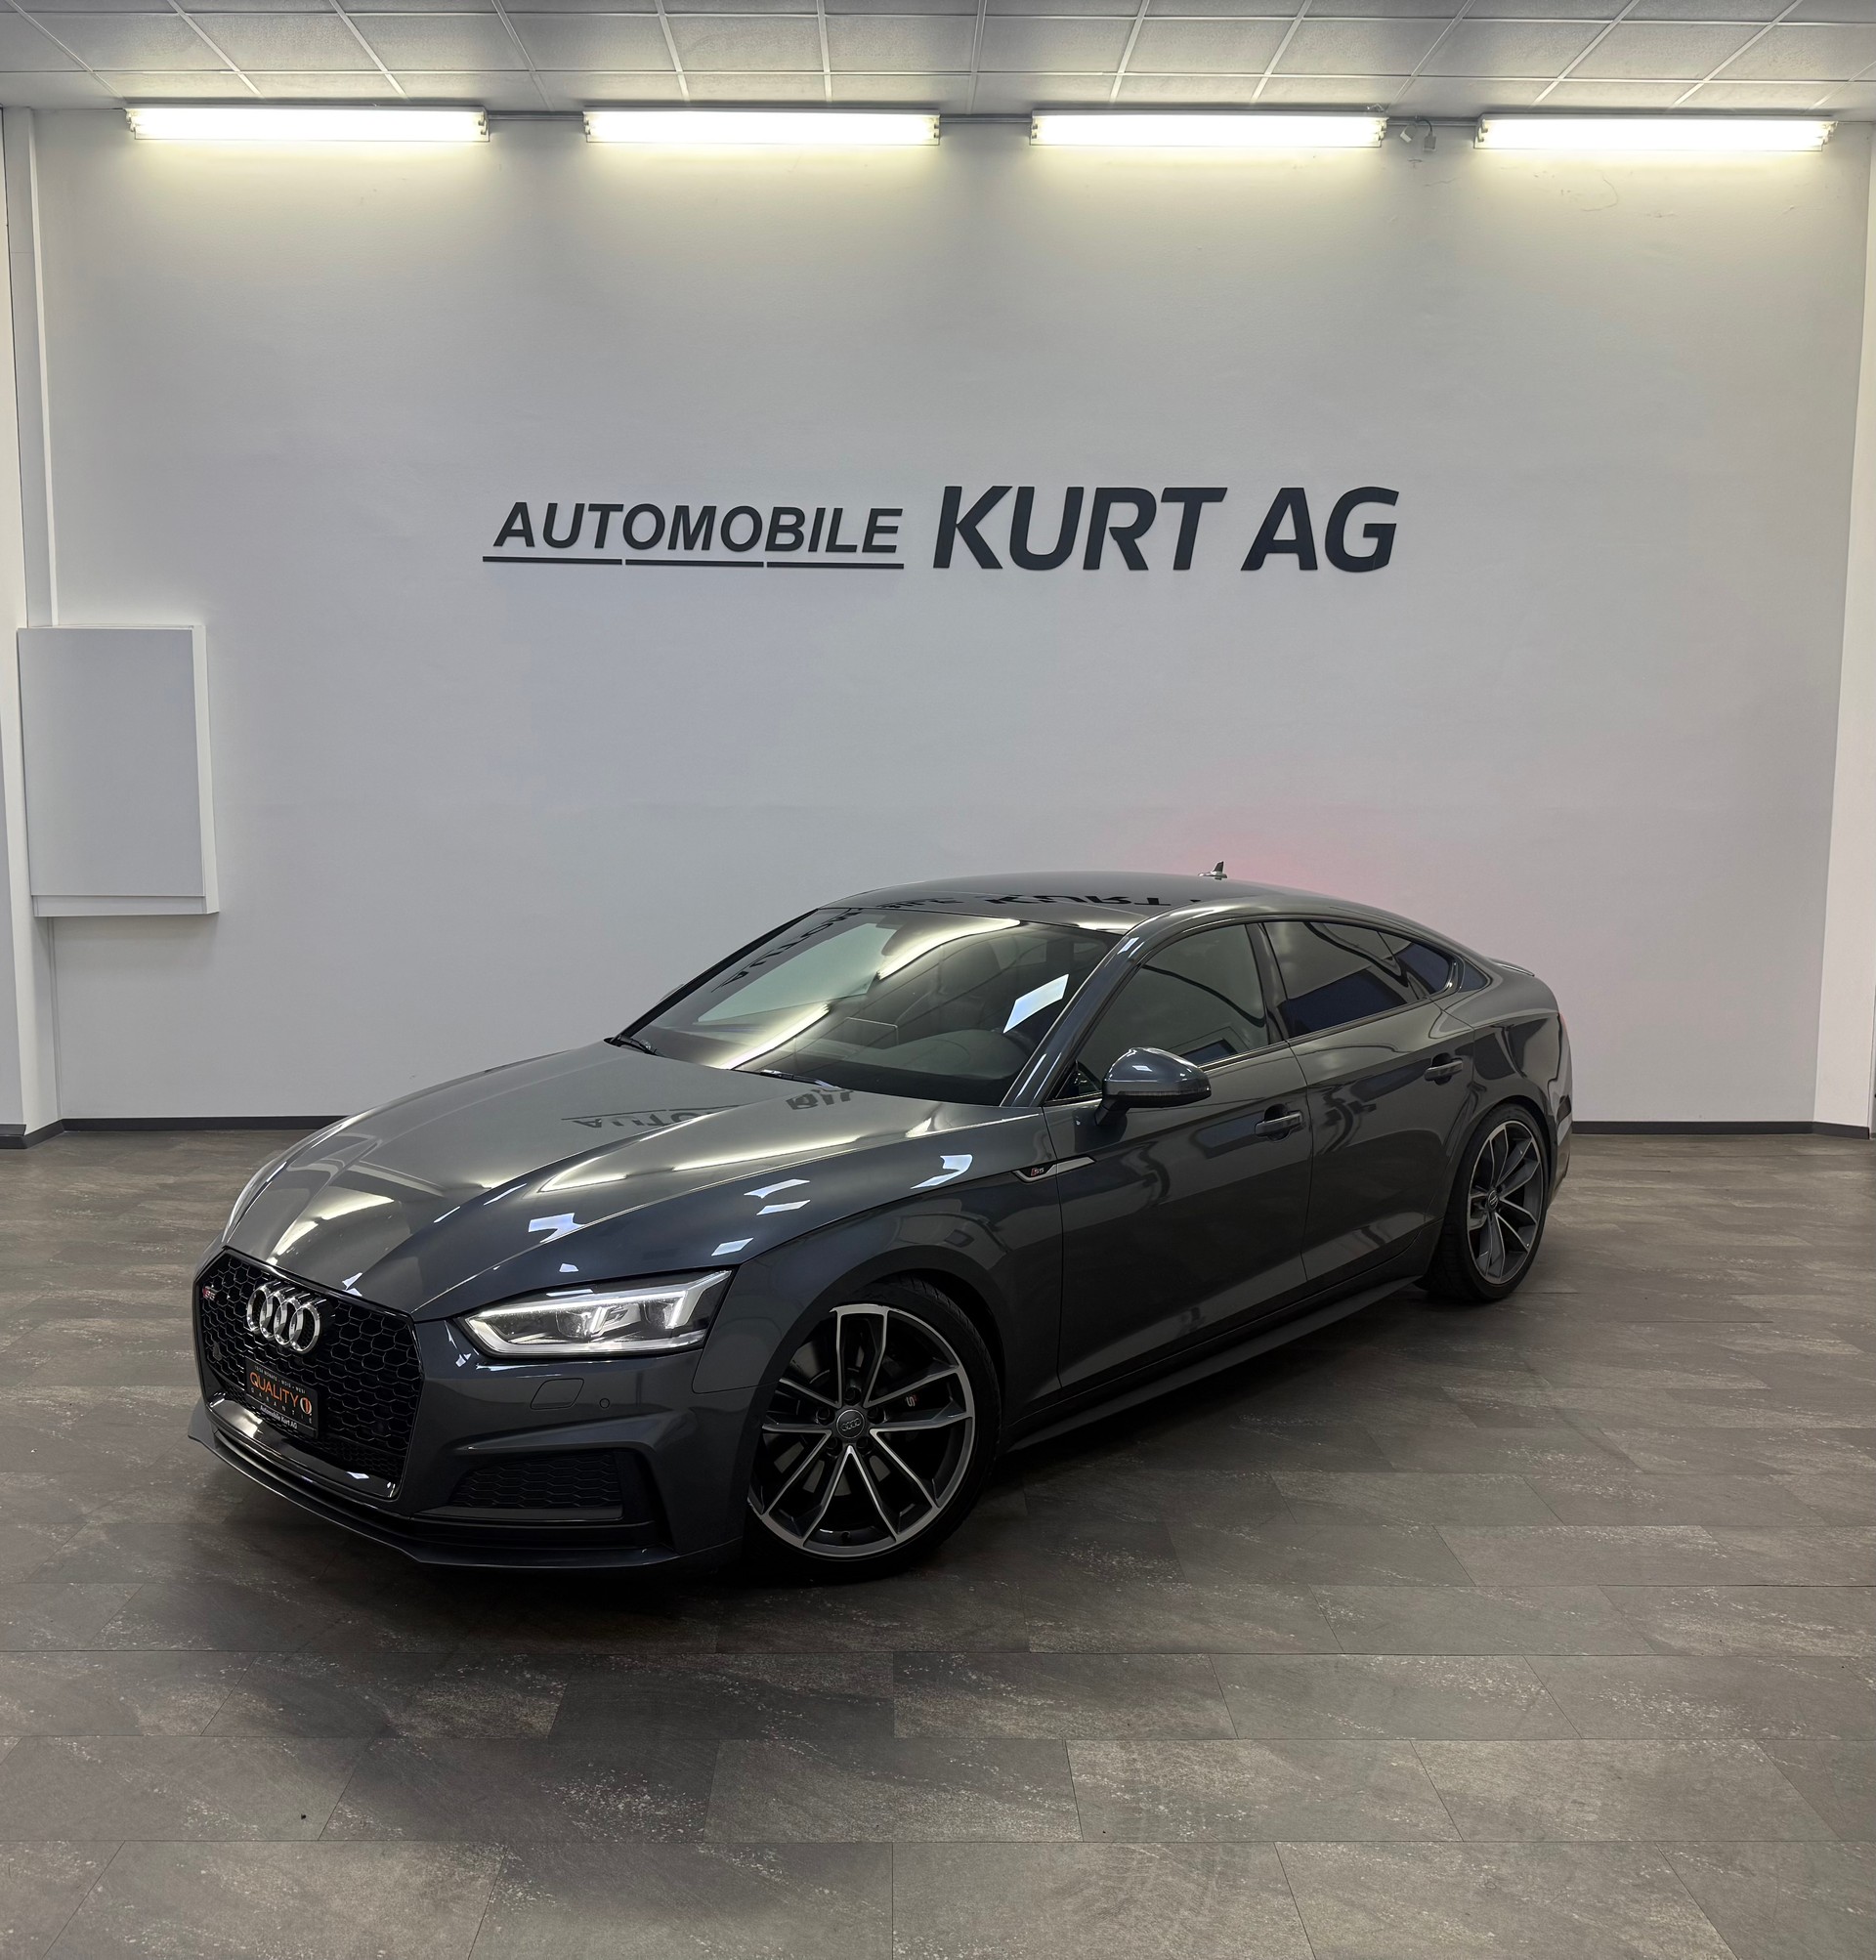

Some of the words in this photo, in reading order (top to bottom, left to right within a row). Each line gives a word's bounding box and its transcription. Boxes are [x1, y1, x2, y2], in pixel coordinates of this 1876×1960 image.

[493, 502, 904, 554] AUTOMOBILE
[933, 486, 1228, 572] KURT
[1241, 487, 1400, 574] AG
[249, 1371, 299, 1408] QUALITY
[250, 1386, 312, 1425] GARANTIE
[260, 1405, 281, 1422] Automobile
[280, 1416, 291, 1427] Kurt
[290, 1421, 298, 1429] AG
